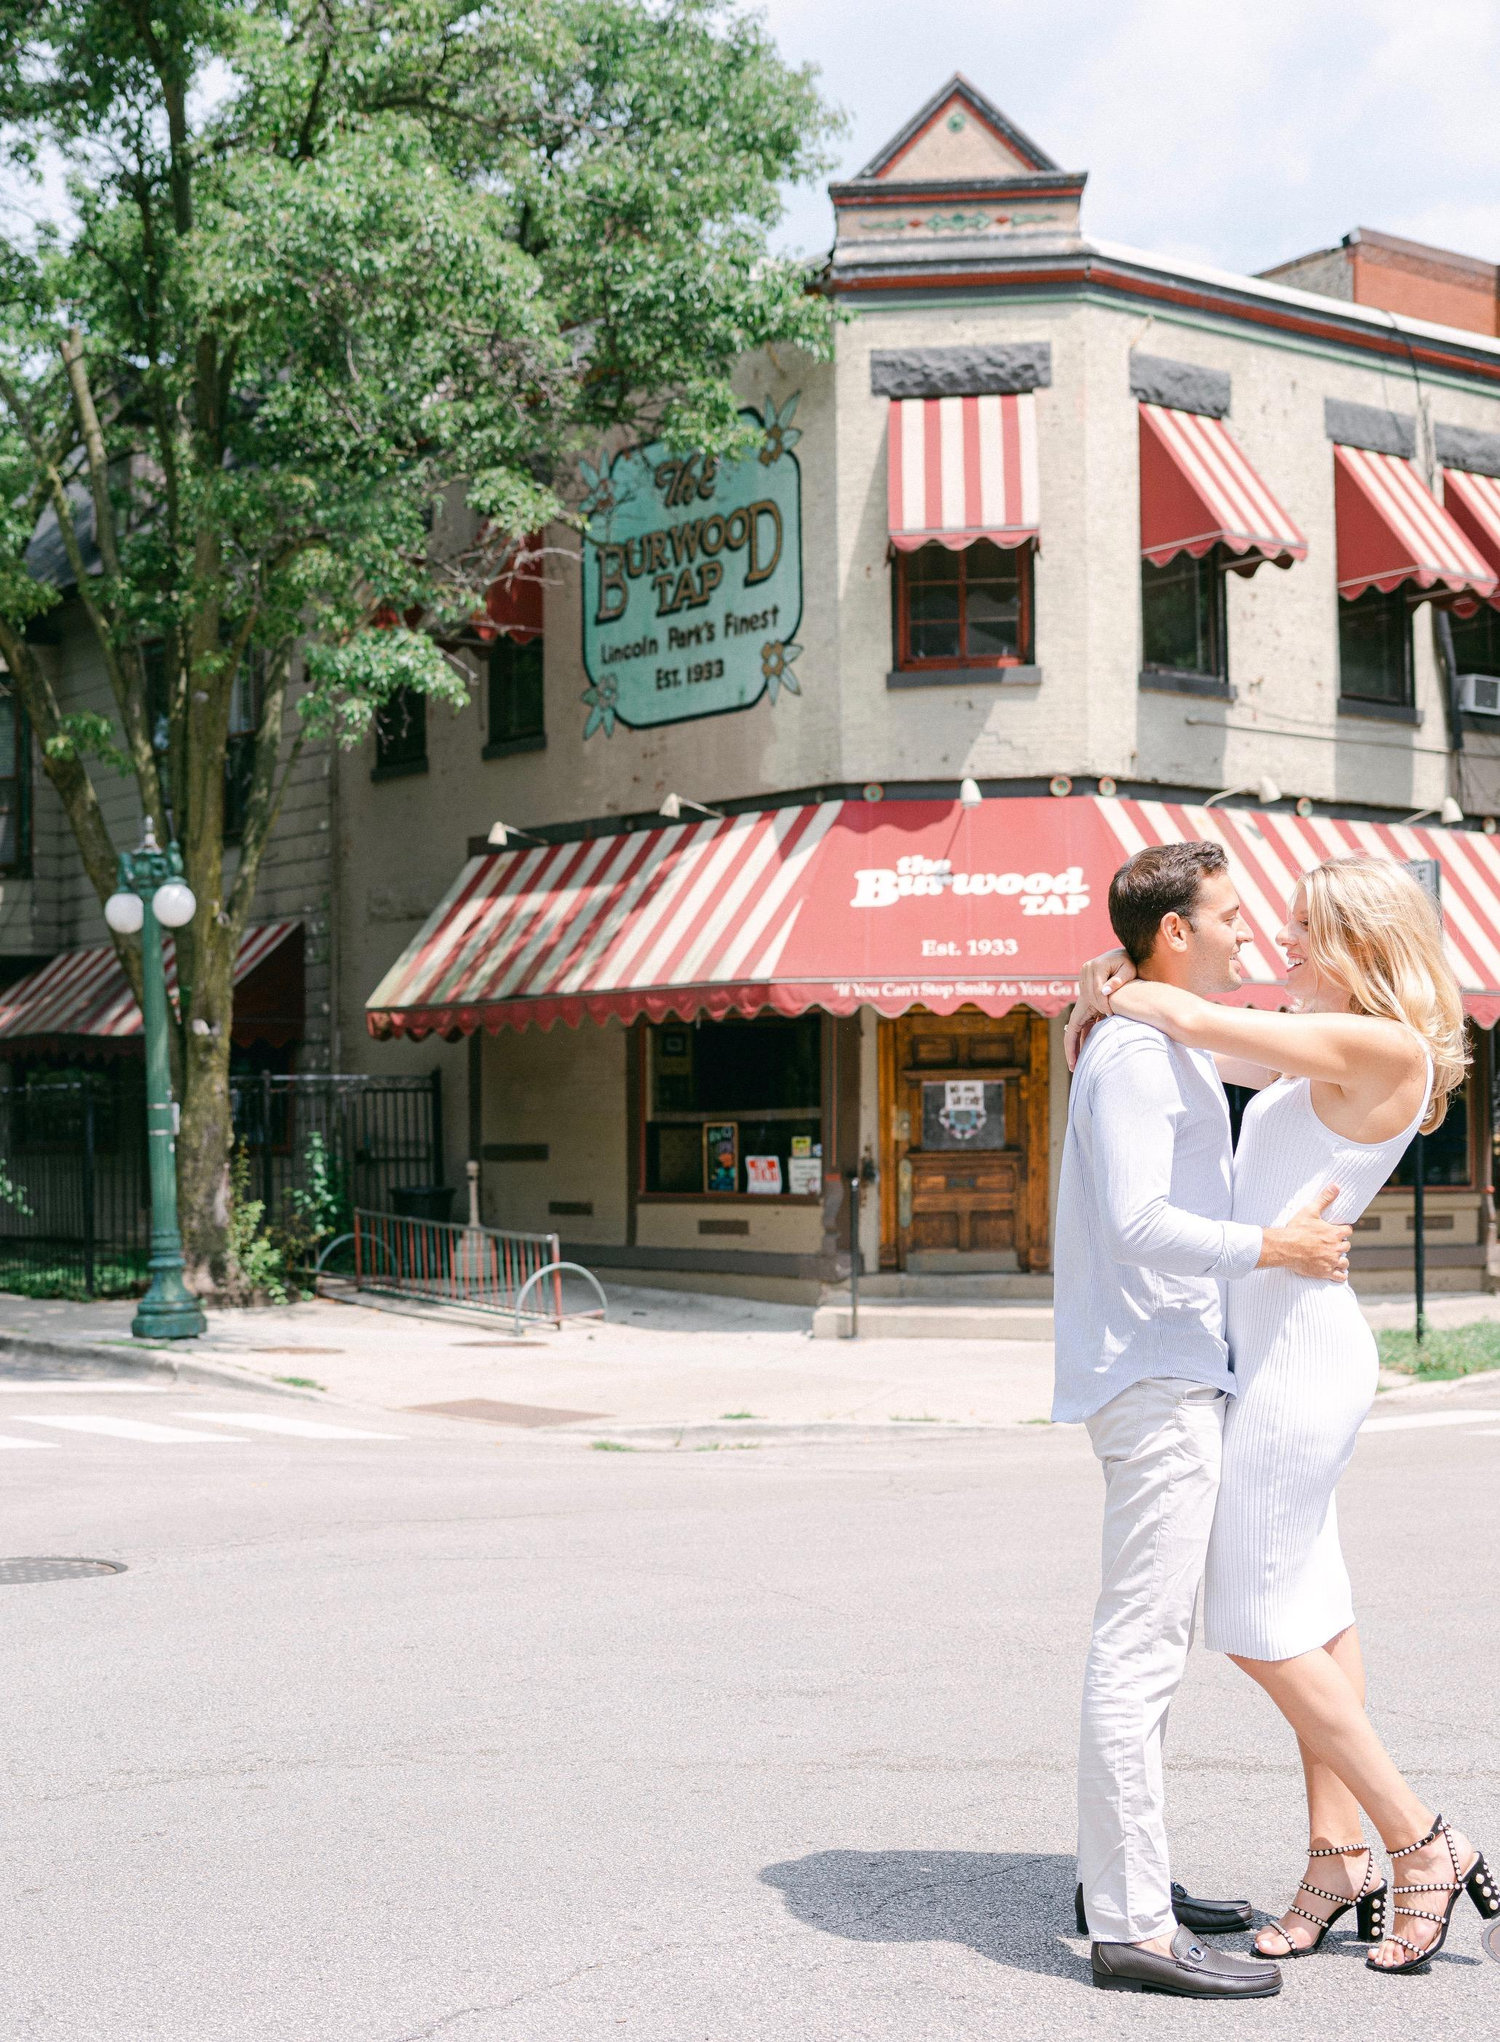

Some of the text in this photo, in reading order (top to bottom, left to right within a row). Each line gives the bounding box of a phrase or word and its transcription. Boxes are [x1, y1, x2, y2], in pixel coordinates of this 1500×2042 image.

[595, 499, 783, 626] BURWOOD
[652, 560, 723, 618] TAP
[601, 604, 781, 665] Lincoln Park's Finest
[687, 658, 725, 683] 1933
[896, 854, 952, 875] the
[849, 866, 1090, 908] Burwood
[1019, 894, 1091, 916] TAP
[921, 938, 1019, 957] Est. 1933
[850, 981, 880, 998] You
[881, 981, 919, 997] Can't
[920, 981, 954, 1000] Stop
[955, 980, 997, 997] Smile
[997, 981, 1018, 996] As
[1018, 980, 1049, 997] You
[1048, 980, 1073, 997] Go
